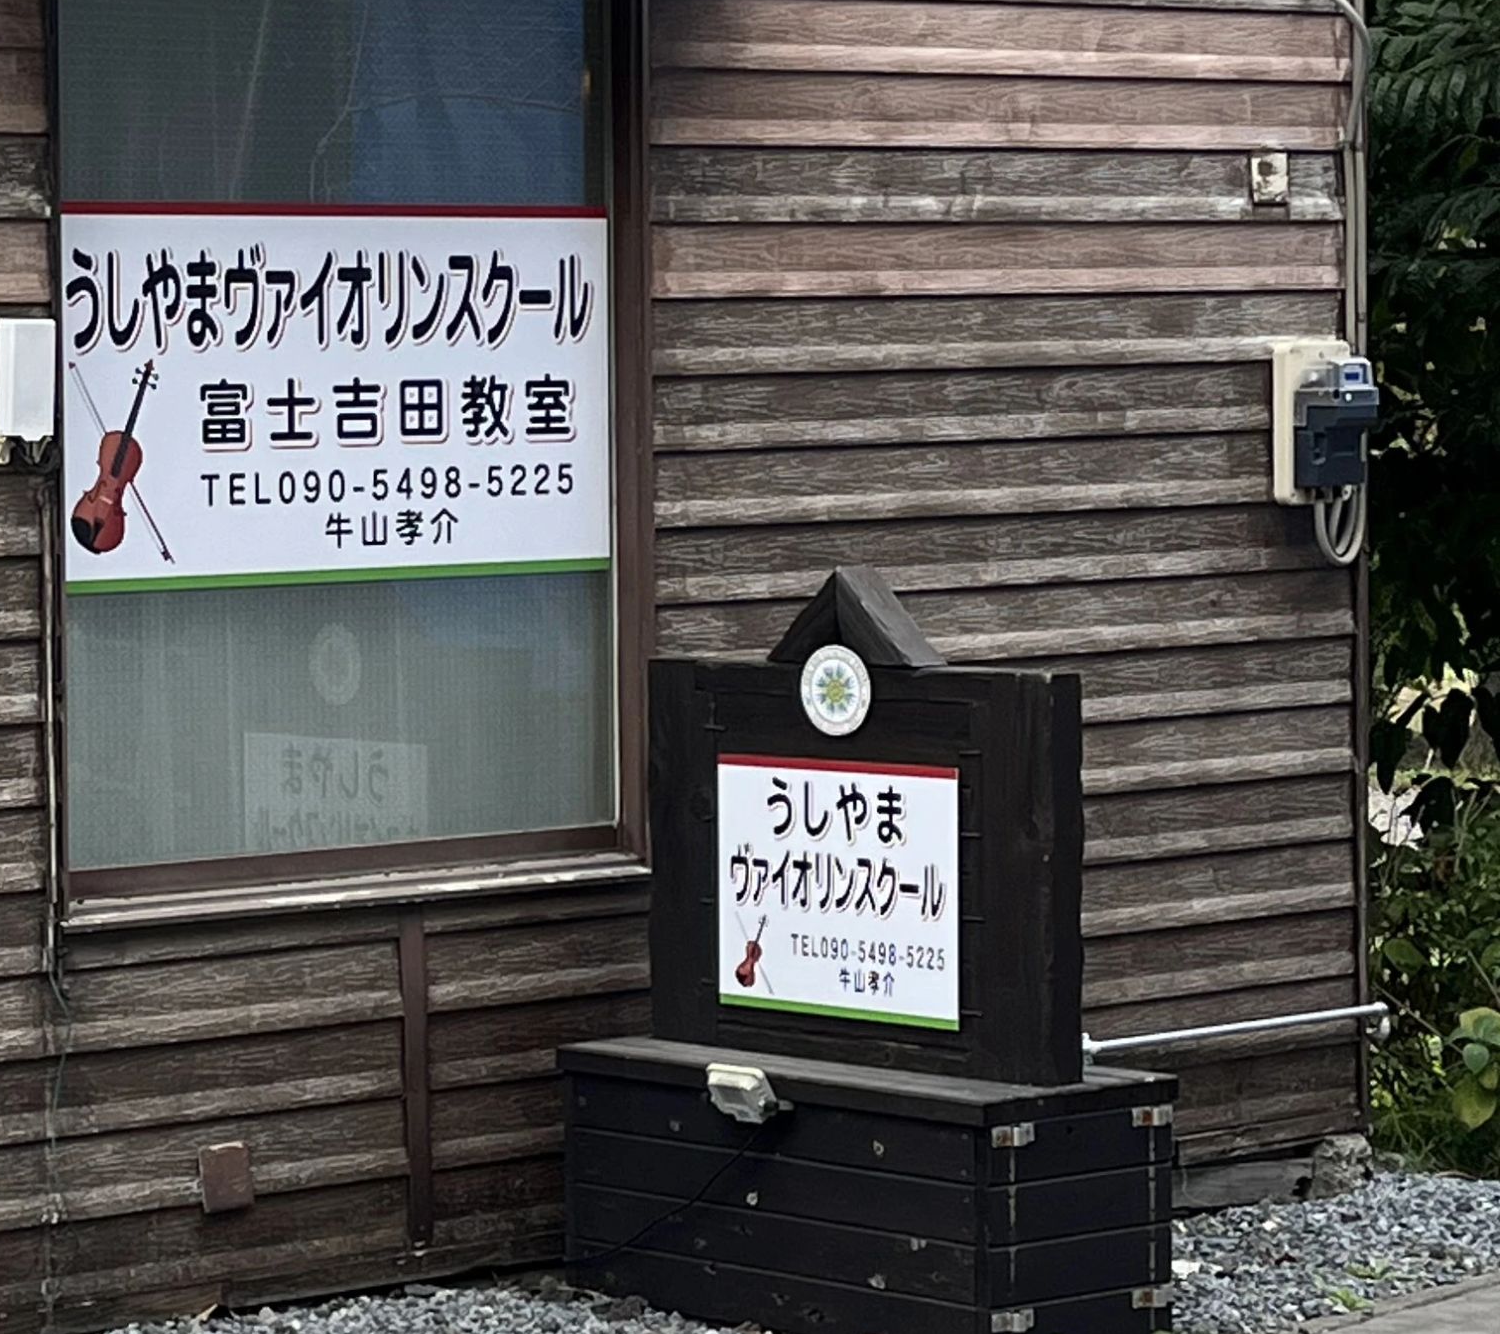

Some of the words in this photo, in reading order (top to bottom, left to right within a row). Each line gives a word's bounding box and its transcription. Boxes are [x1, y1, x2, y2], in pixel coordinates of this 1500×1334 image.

[65, 245, 591, 353] うしやまヴァイオリンスクール
[199, 375, 574, 446] 富士吉田教室
[201, 463, 575, 507] TEL090-5498-5225
[325, 507, 459, 548] 牛山孝介
[766, 776, 908, 843] うしやま
[729, 842, 946, 920] ヴァイオリンスクール
[790, 933, 946, 971] TEL090-5498-5225
[838, 967, 895, 997] 牛山孝介
